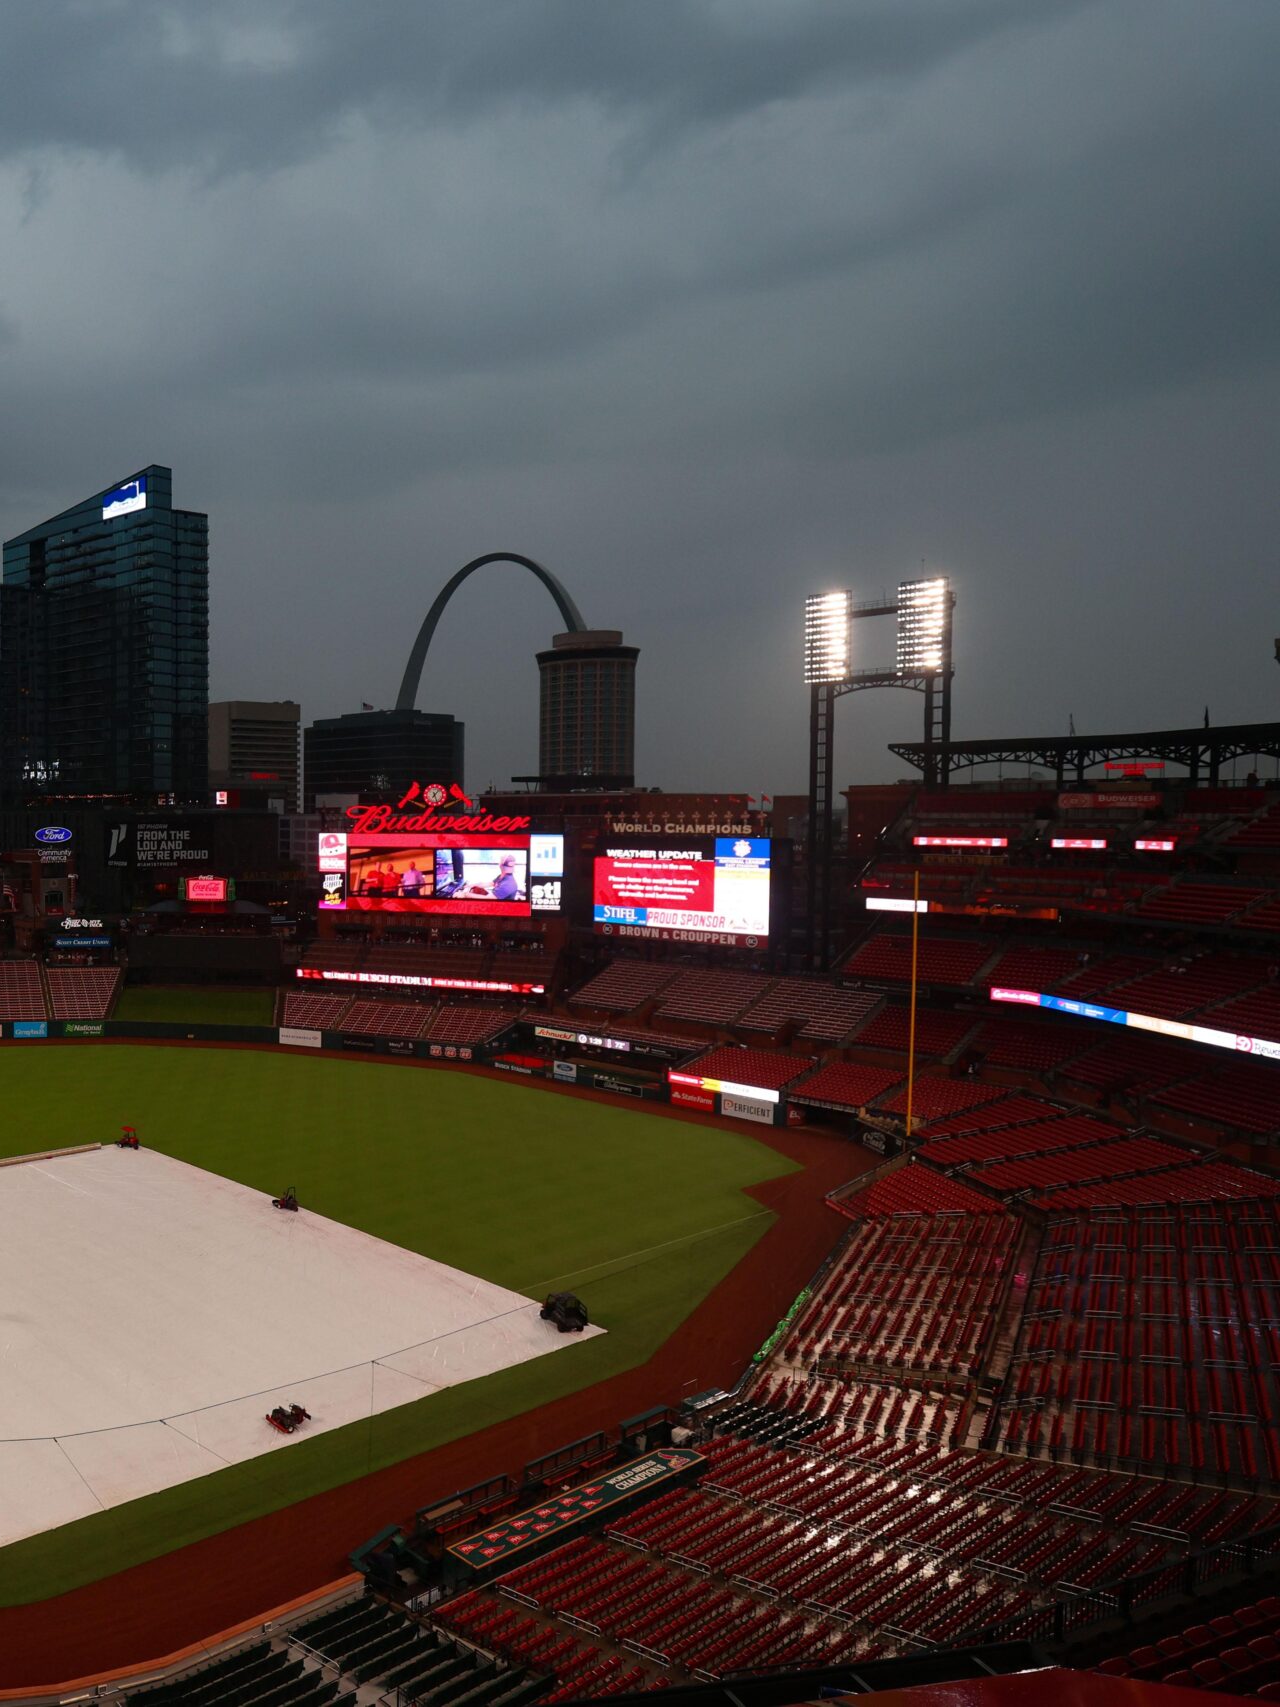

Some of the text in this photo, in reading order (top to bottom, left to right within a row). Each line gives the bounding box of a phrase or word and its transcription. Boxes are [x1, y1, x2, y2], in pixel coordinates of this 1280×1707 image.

[1098, 794, 1157, 802] BUDWEISER
[346, 805, 531, 833] Budweiser
[137, 830, 191, 841] FROM THE
[613, 823, 753, 835] WORLD CHAMPIONS
[37, 848, 72, 858] Community
[137, 841, 183, 851] LOU AND
[136, 850, 209, 861] WE'RE PROUD
[606, 849, 703, 861] WEATHER UPDATE
[532, 882, 561, 899] stl
[604, 905, 638, 919] STIFEL
[648, 911, 726, 929] PROUD SPONSOR
[619, 925, 737, 945] BROWN & CROUPPEN
[359, 972, 390, 984] BUSCH
[390, 975, 433, 987] STADIUM
[73, 1024, 102, 1032] National
[723, 1100, 771, 1118] PERFICIENT
[605, 1470, 635, 1485] WORLD
[615, 1463, 667, 1490] CHAMPIONS
